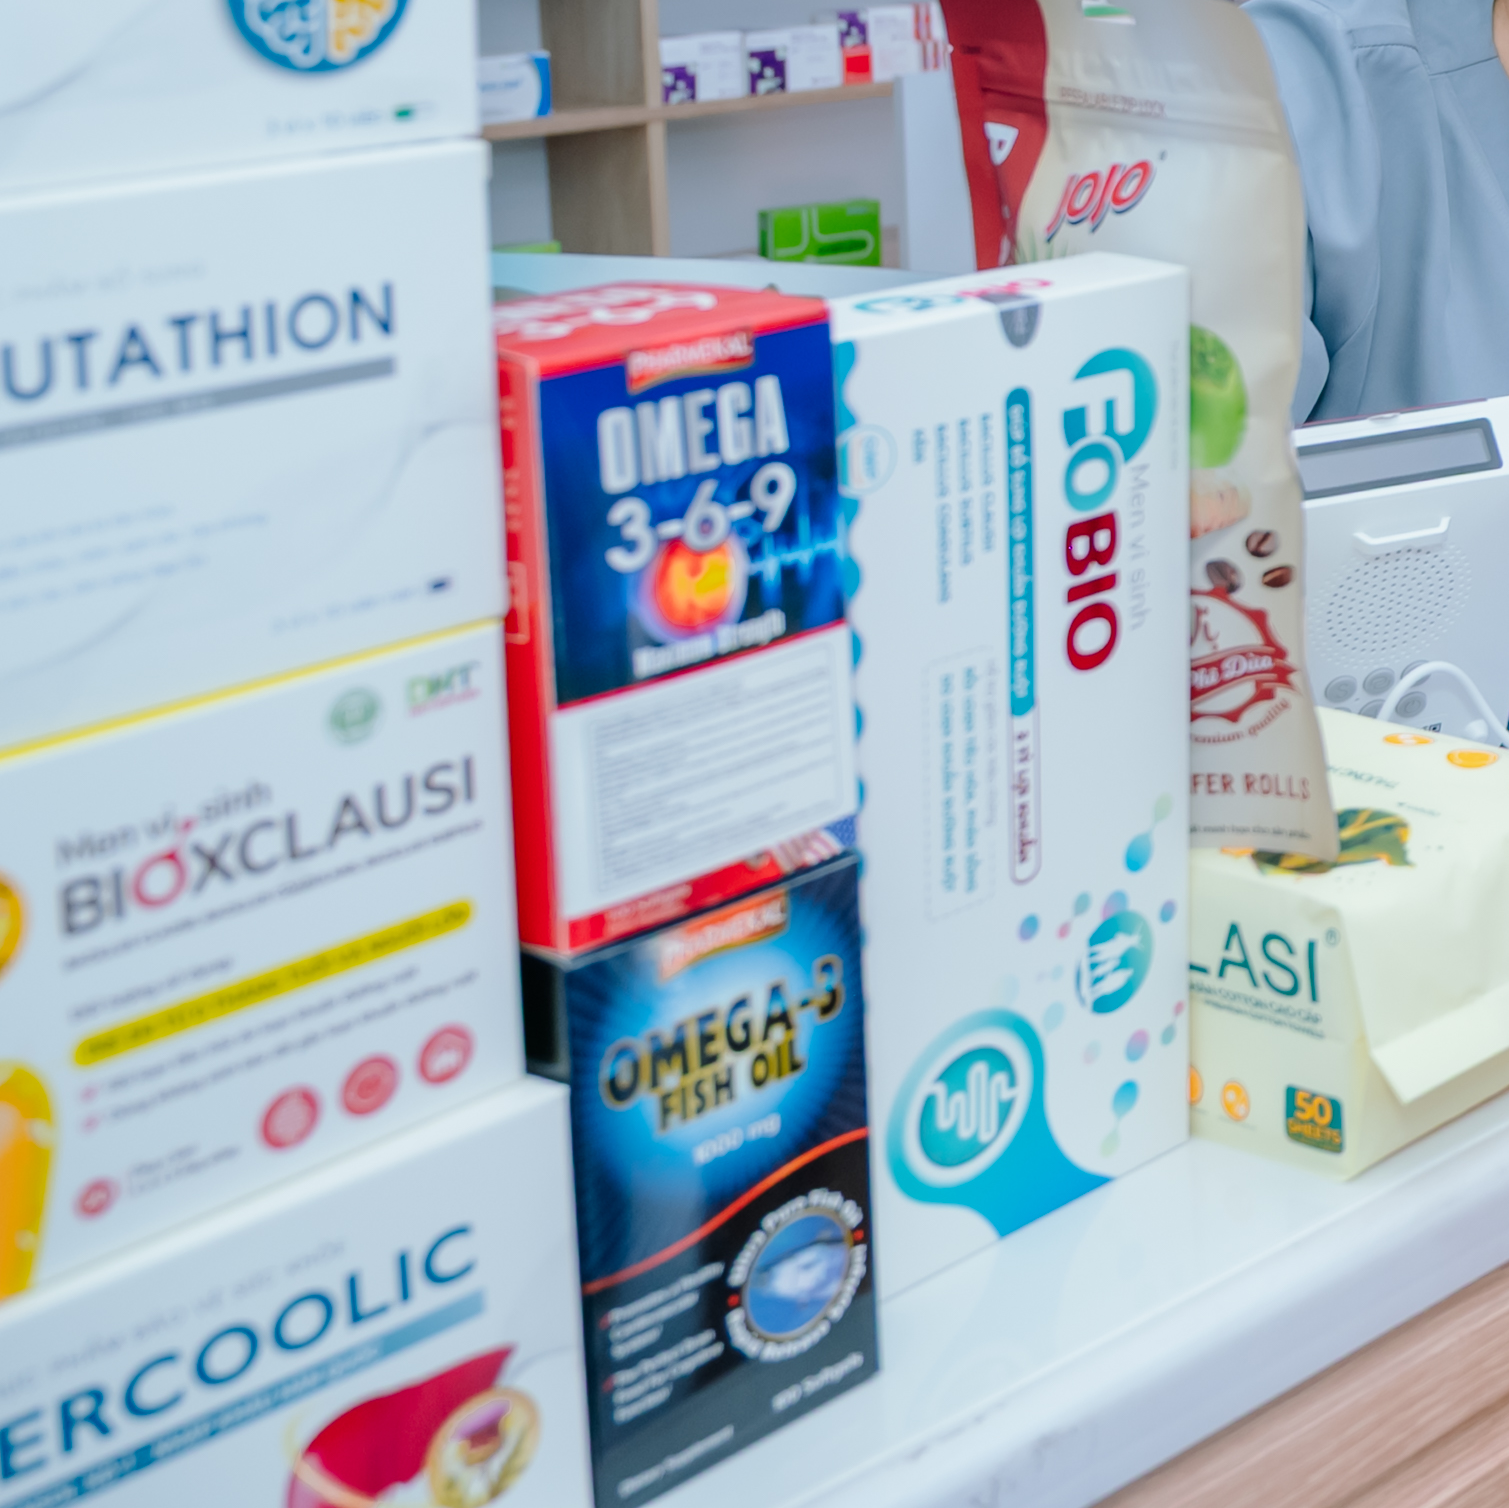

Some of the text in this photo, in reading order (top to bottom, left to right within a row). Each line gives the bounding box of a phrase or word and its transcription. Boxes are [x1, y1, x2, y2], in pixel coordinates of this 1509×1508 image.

[598, 374, 791, 495] OMEGA
[605, 462, 797, 574] 3-6-9
[1124, 462, 1153, 632] Men vi sinh
[56, 824, 141, 867] Men
[202, 779, 273, 824] sinh
[1190, 771, 1314, 802] FER ROLLS
[62, 754, 478, 938] BIOXCLAUSI
[602, 955, 845, 1110] OMEGA-3
[656, 1030, 806, 1136] FISH OIL
[746, 1113, 780, 1154] mg
[1294, 1089, 1333, 1128] 50
